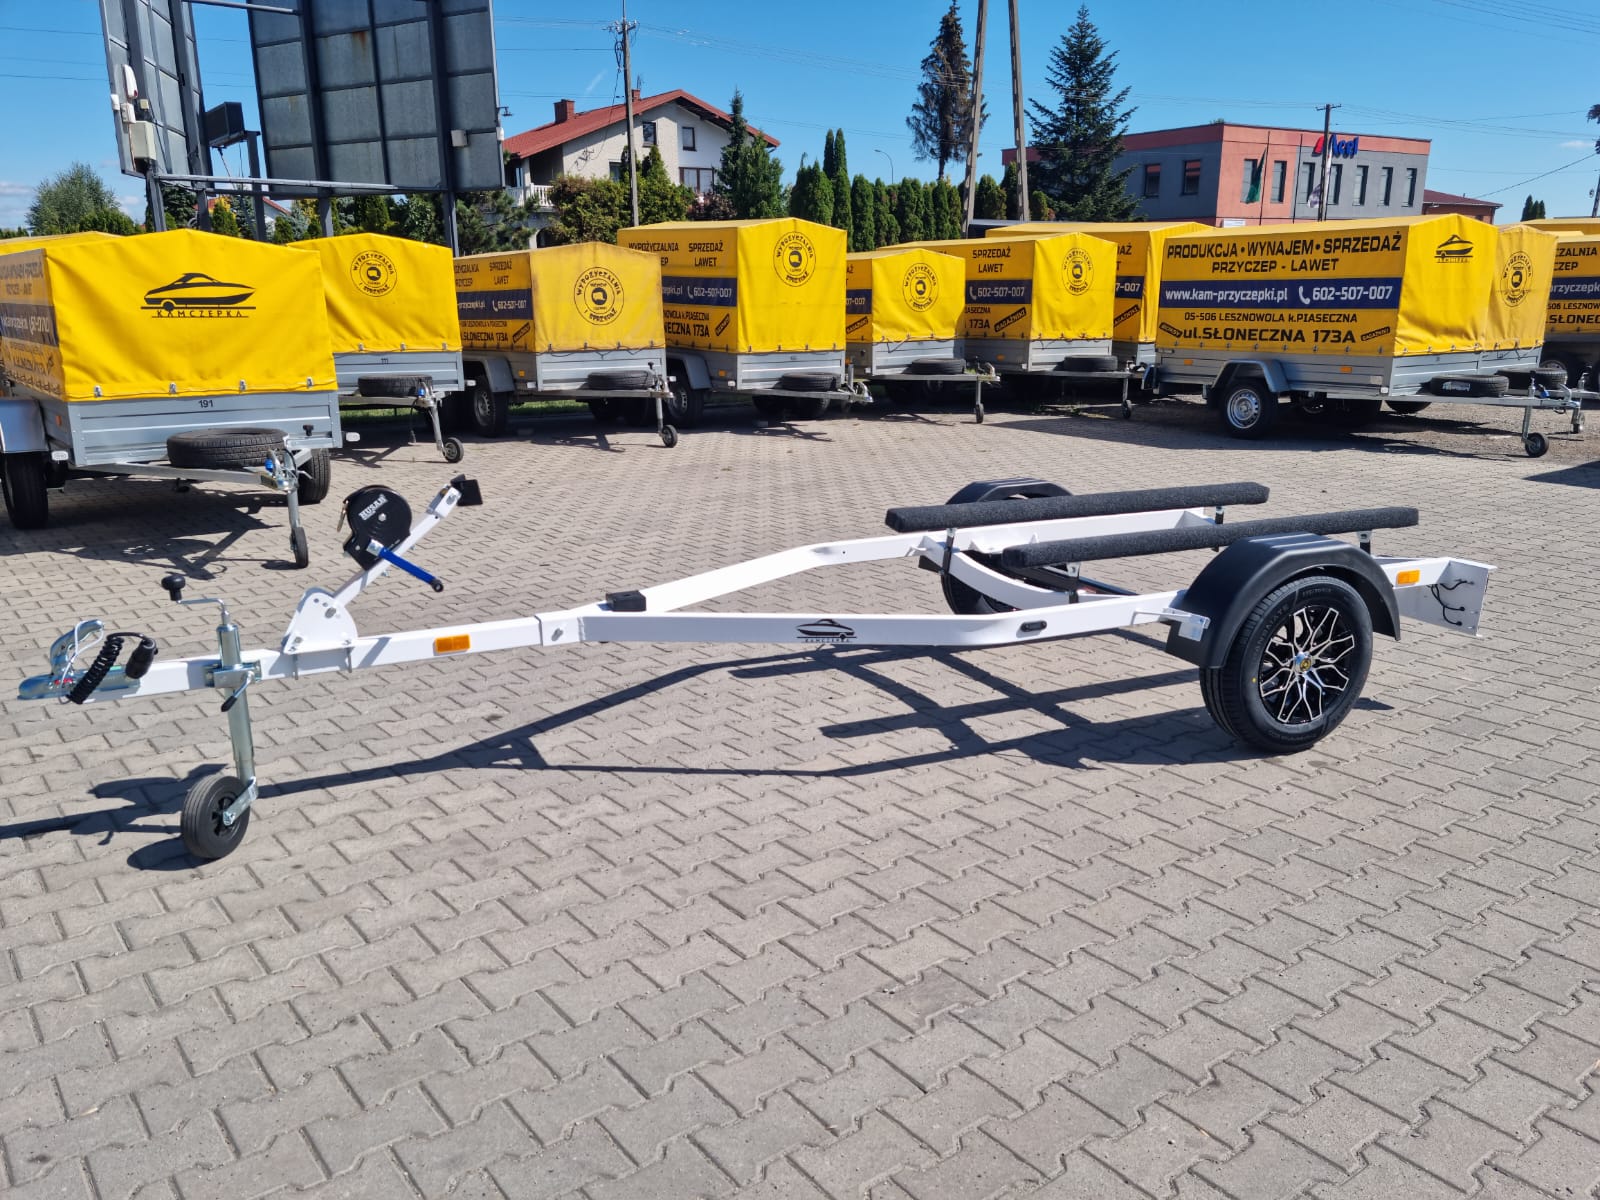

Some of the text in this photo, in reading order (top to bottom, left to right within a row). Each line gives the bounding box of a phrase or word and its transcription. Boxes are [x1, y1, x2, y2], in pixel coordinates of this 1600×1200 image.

[689, 240, 724, 252] SPRZEDAŻ
[1167, 231, 1402, 259] PRODUKCJA WYNAJEM SPRZEDAŻ
[972, 246, 1011, 259] SPRZEDAŻ
[694, 257, 717, 267] LAWET
[978, 263, 1004, 273] LAWET
[1212, 260, 1277, 274] PRZYCZEP
[1290, 258, 1340, 272] LAWET
[977, 286, 1025, 297] 602-507-007
[1165, 285, 1393, 303] www.kam-przyczepki.pl 602-507-007
[969, 318, 990, 329] 173A
[1184, 312, 1358, 324] 05-506 LESZNOWOLA k.PIASECZNA
[693, 324, 710, 337] 173A
[1183, 326, 1356, 344] ul.SŁONECZNA 173A
[198, 399, 214, 408] 191
